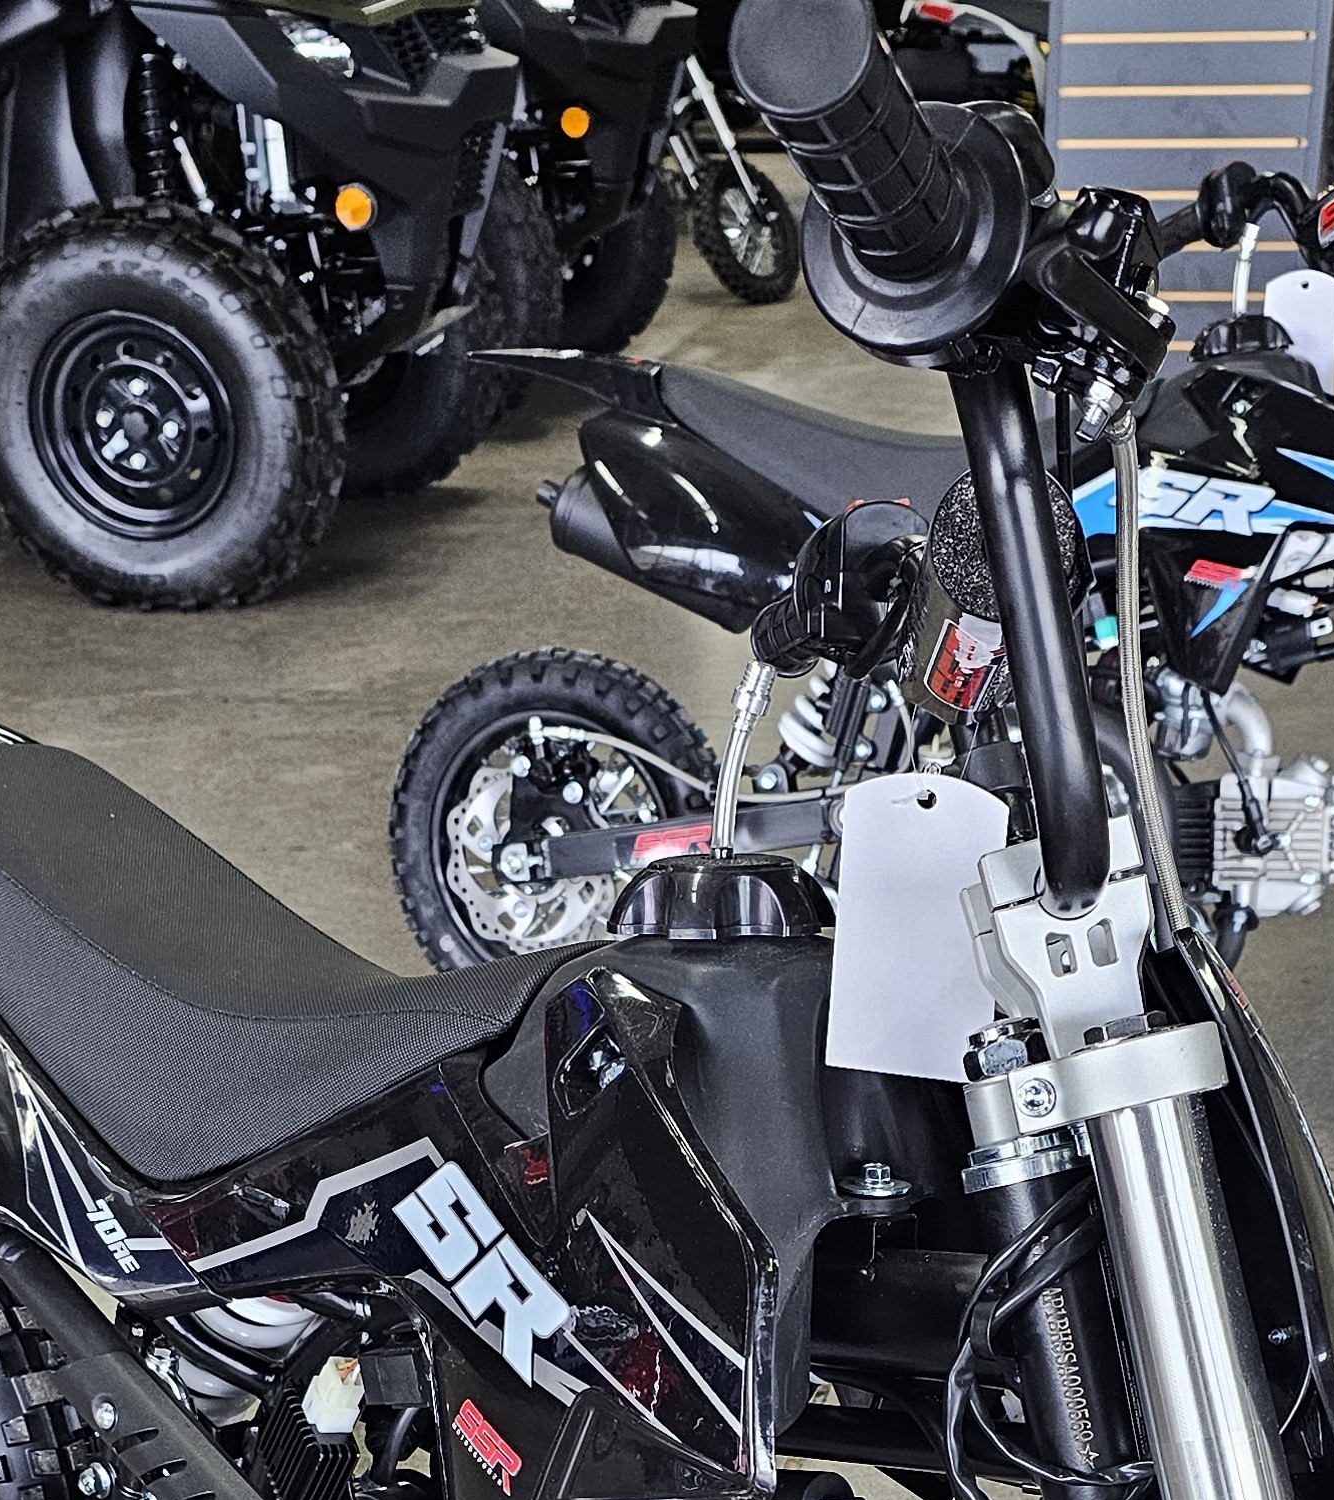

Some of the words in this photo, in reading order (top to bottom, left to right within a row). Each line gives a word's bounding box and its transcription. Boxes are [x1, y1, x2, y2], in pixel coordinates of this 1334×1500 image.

[1109, 466, 1276, 536] SR
[392, 1160, 569, 1388] SR
[454, 1398, 522, 1496] SSR
